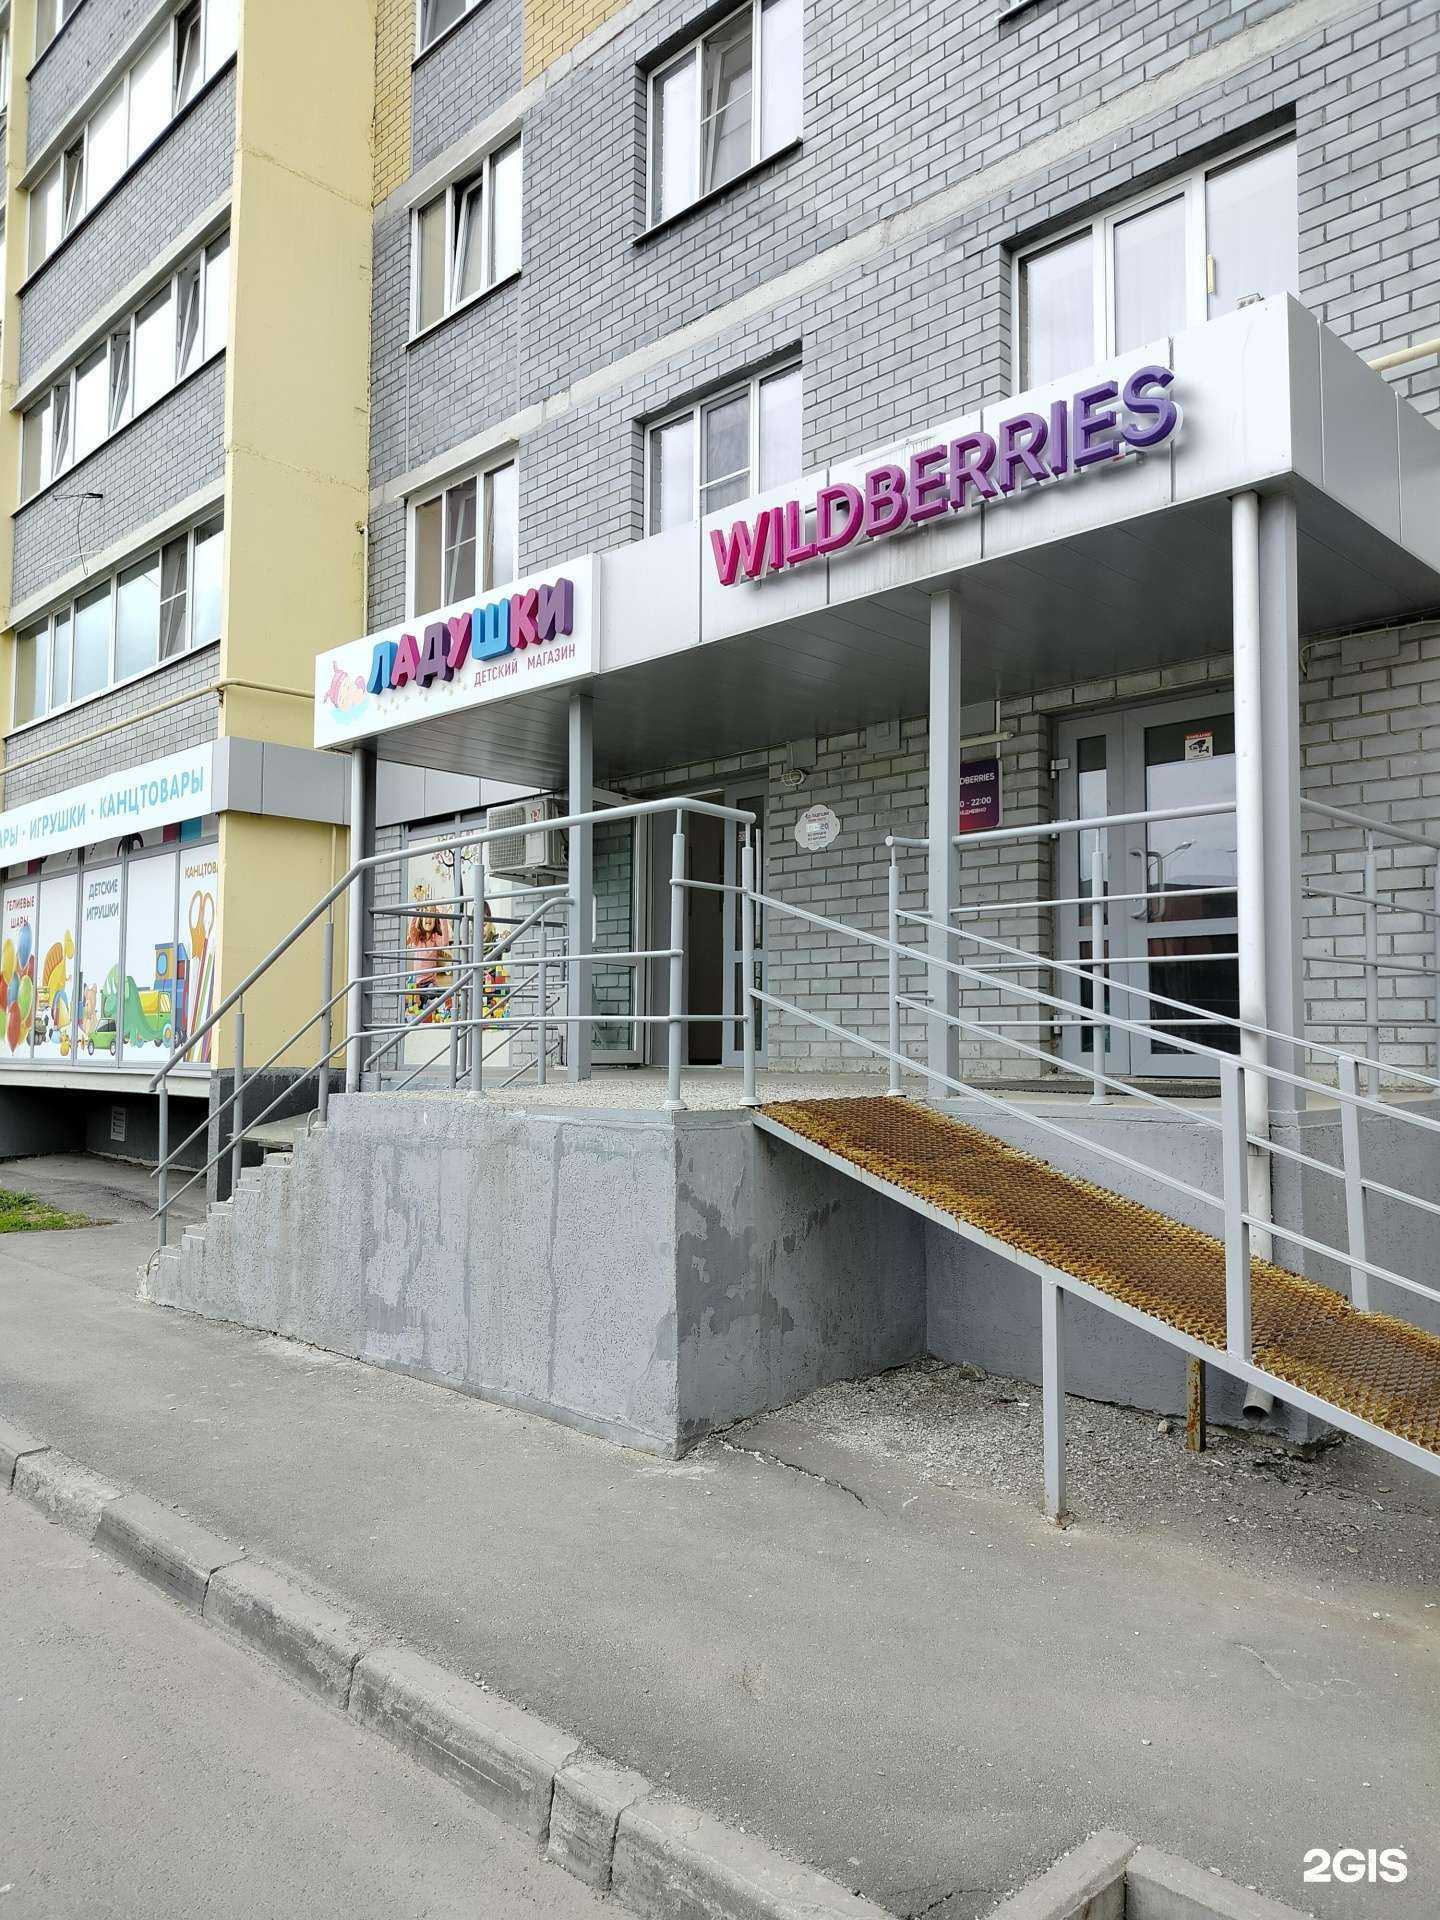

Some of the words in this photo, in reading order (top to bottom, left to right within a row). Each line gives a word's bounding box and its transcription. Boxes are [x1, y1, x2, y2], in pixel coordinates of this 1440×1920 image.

[710, 365, 1179, 587] WILDBERRIES
[367, 577, 574, 695] ЛАДУШКИ
[474, 658, 518, 688] ДЕТСКИЙ
[527, 643, 576, 671] МАГАЗИН
[960, 772, 995, 785] DBERRIES
[29, 803, 86, 840] ИГРУШКИ
[99, 766, 204, 819] КАНЦТОВАРЫ
[971, 796, 992, 806] 22:00
[184, 861, 218, 879] КАНЦТОВ
[88, 878, 118, 898] ДЕТСКИЕ
[6, 895, 35, 912] ГЕЛИЕВЫЕ
[86, 902, 119, 921] ИГРУШКИ
[10, 916, 29, 929] ШАРЫ
